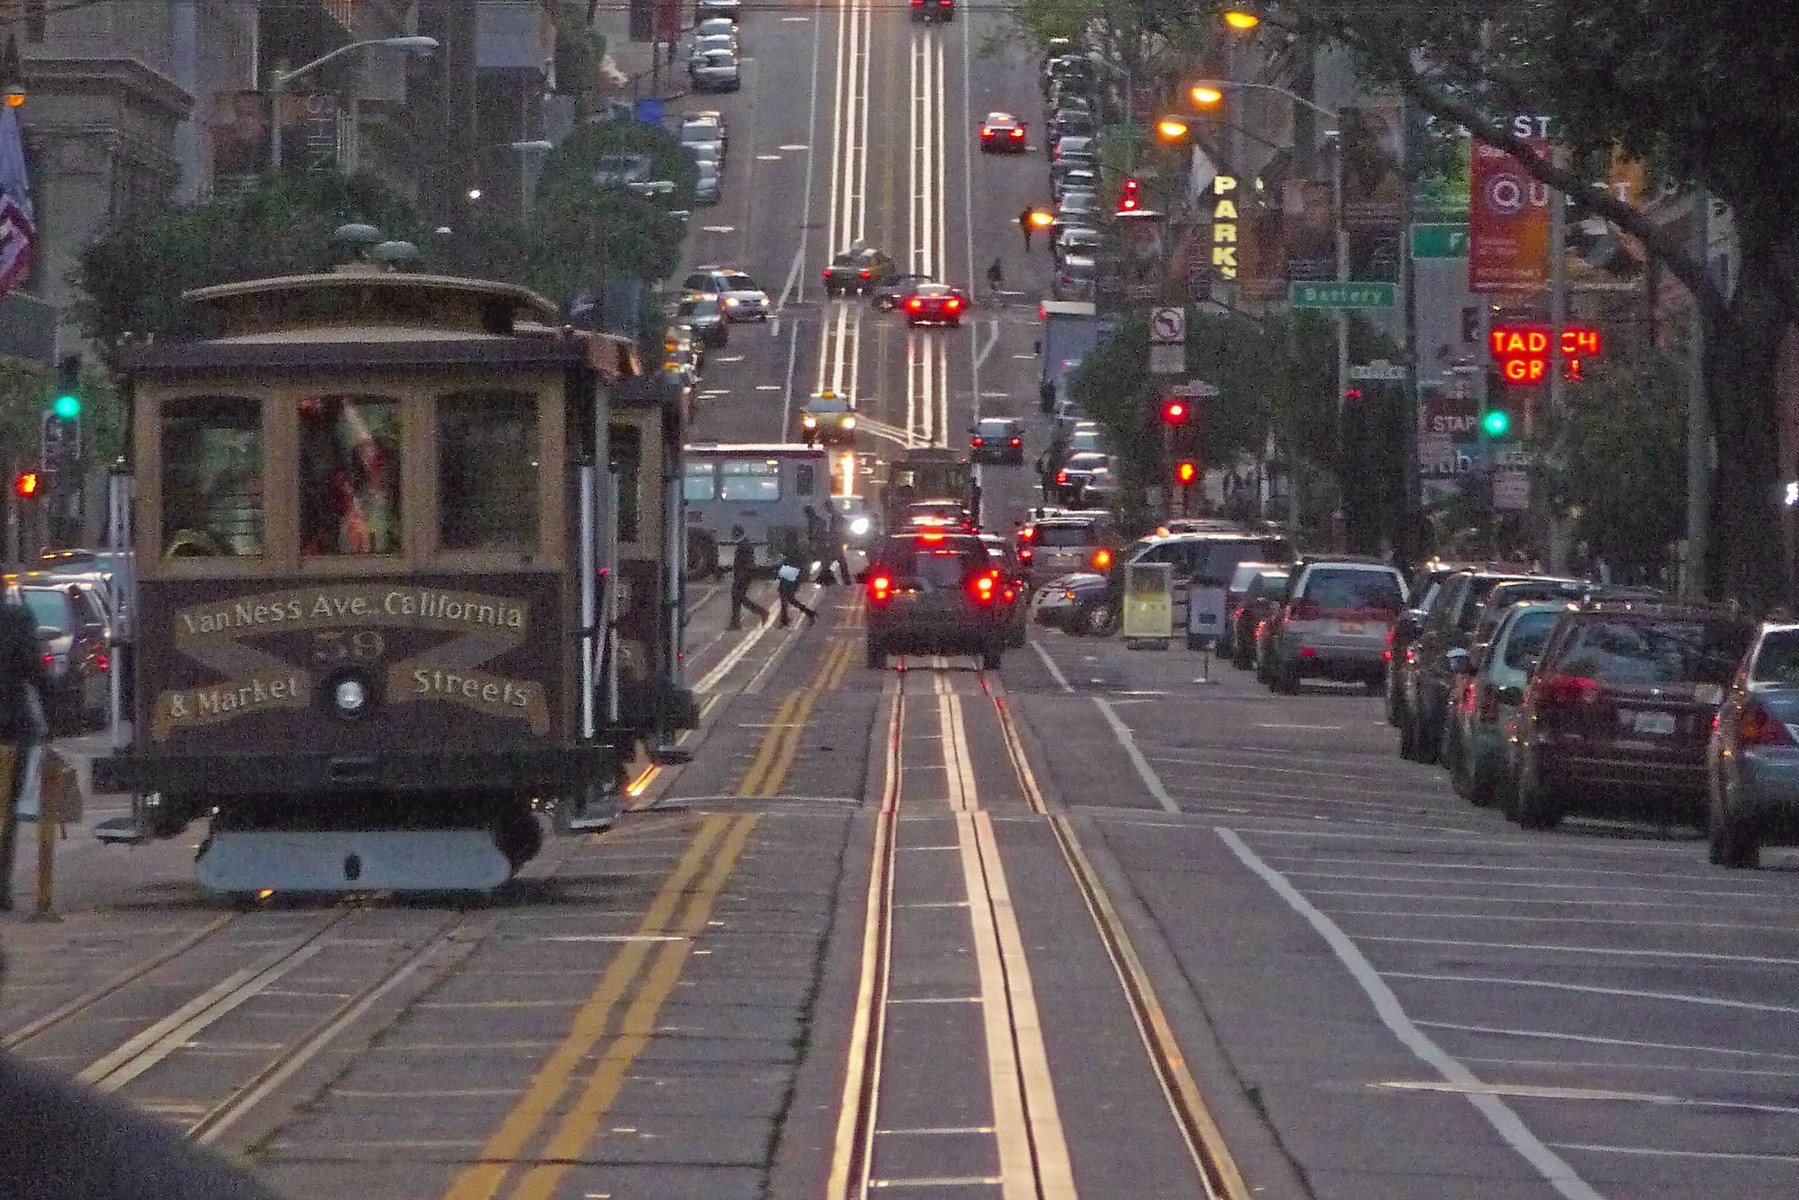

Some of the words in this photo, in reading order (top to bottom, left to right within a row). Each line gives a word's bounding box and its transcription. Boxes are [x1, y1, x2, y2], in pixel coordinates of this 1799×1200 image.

[1304, 287, 1383, 305] Battery
[182, 609, 230, 636] Van
[235, 597, 303, 628] Ness
[383, 592, 525, 629] California
[170, 693, 190, 718] &
[197, 676, 299, 717] Market
[413, 668, 530, 707] Streets
